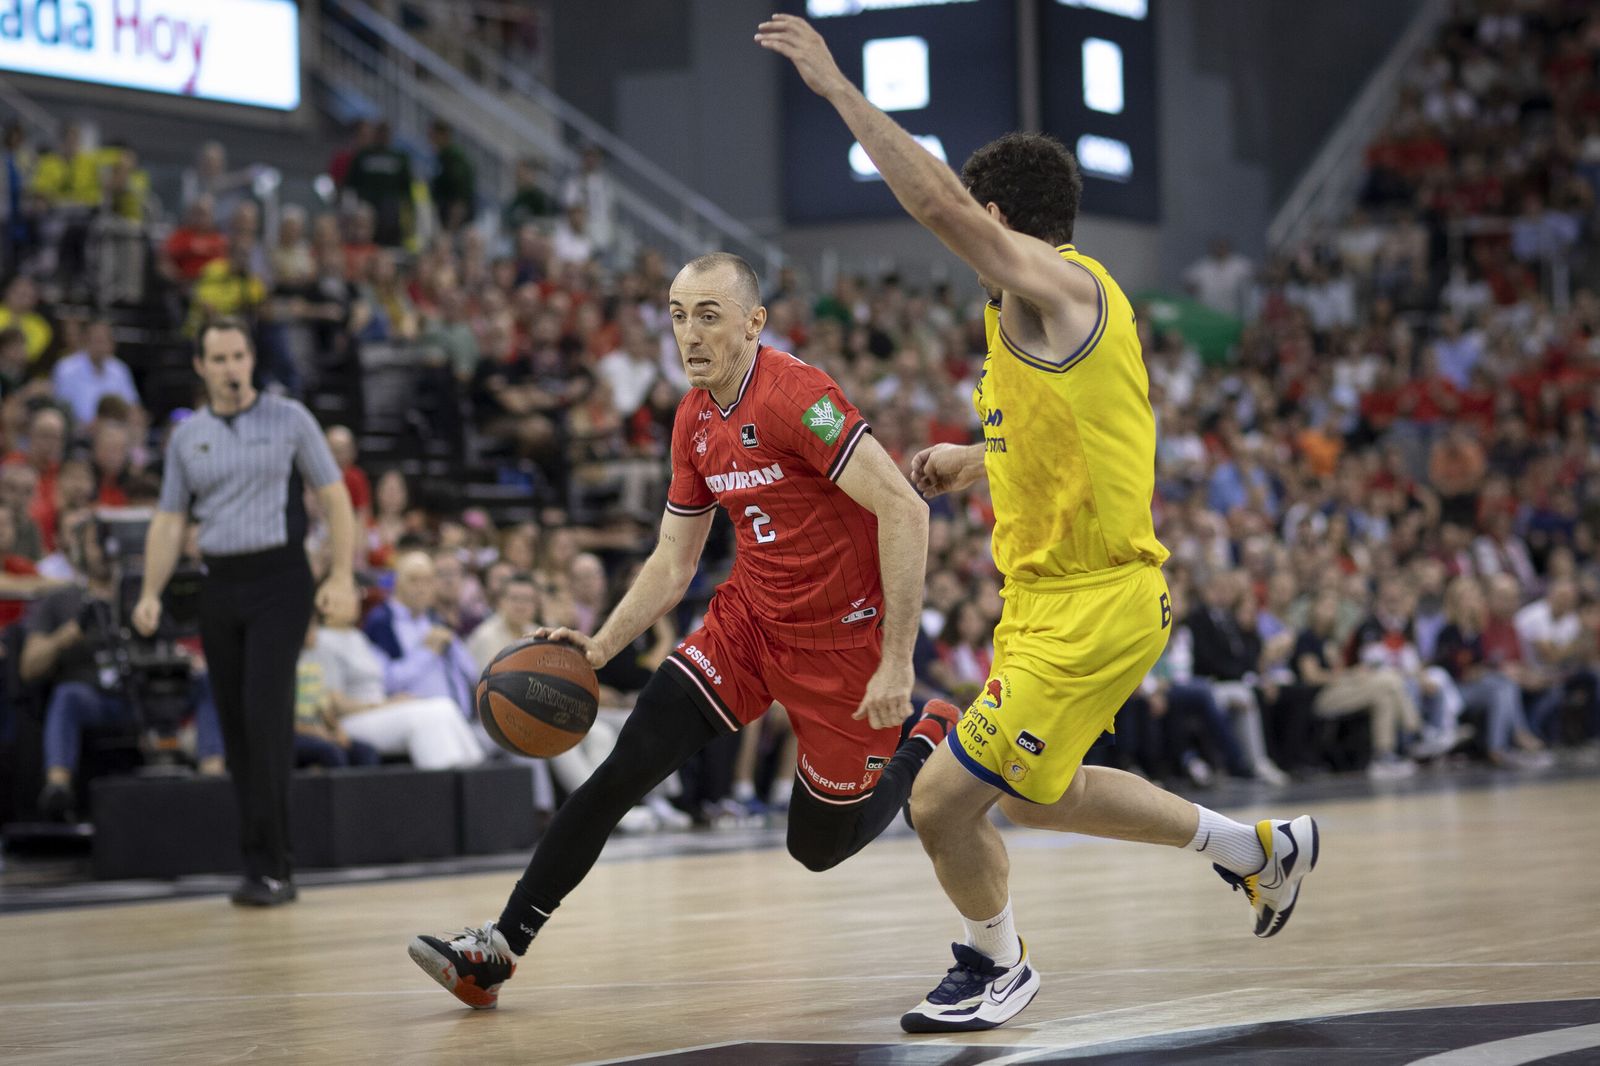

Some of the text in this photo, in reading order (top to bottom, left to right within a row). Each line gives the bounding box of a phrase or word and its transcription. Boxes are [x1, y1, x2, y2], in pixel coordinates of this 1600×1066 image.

[112, 0, 208, 96] Hoy
[745, 505, 777, 544] 2
[1018, 736, 1038, 752] acb
